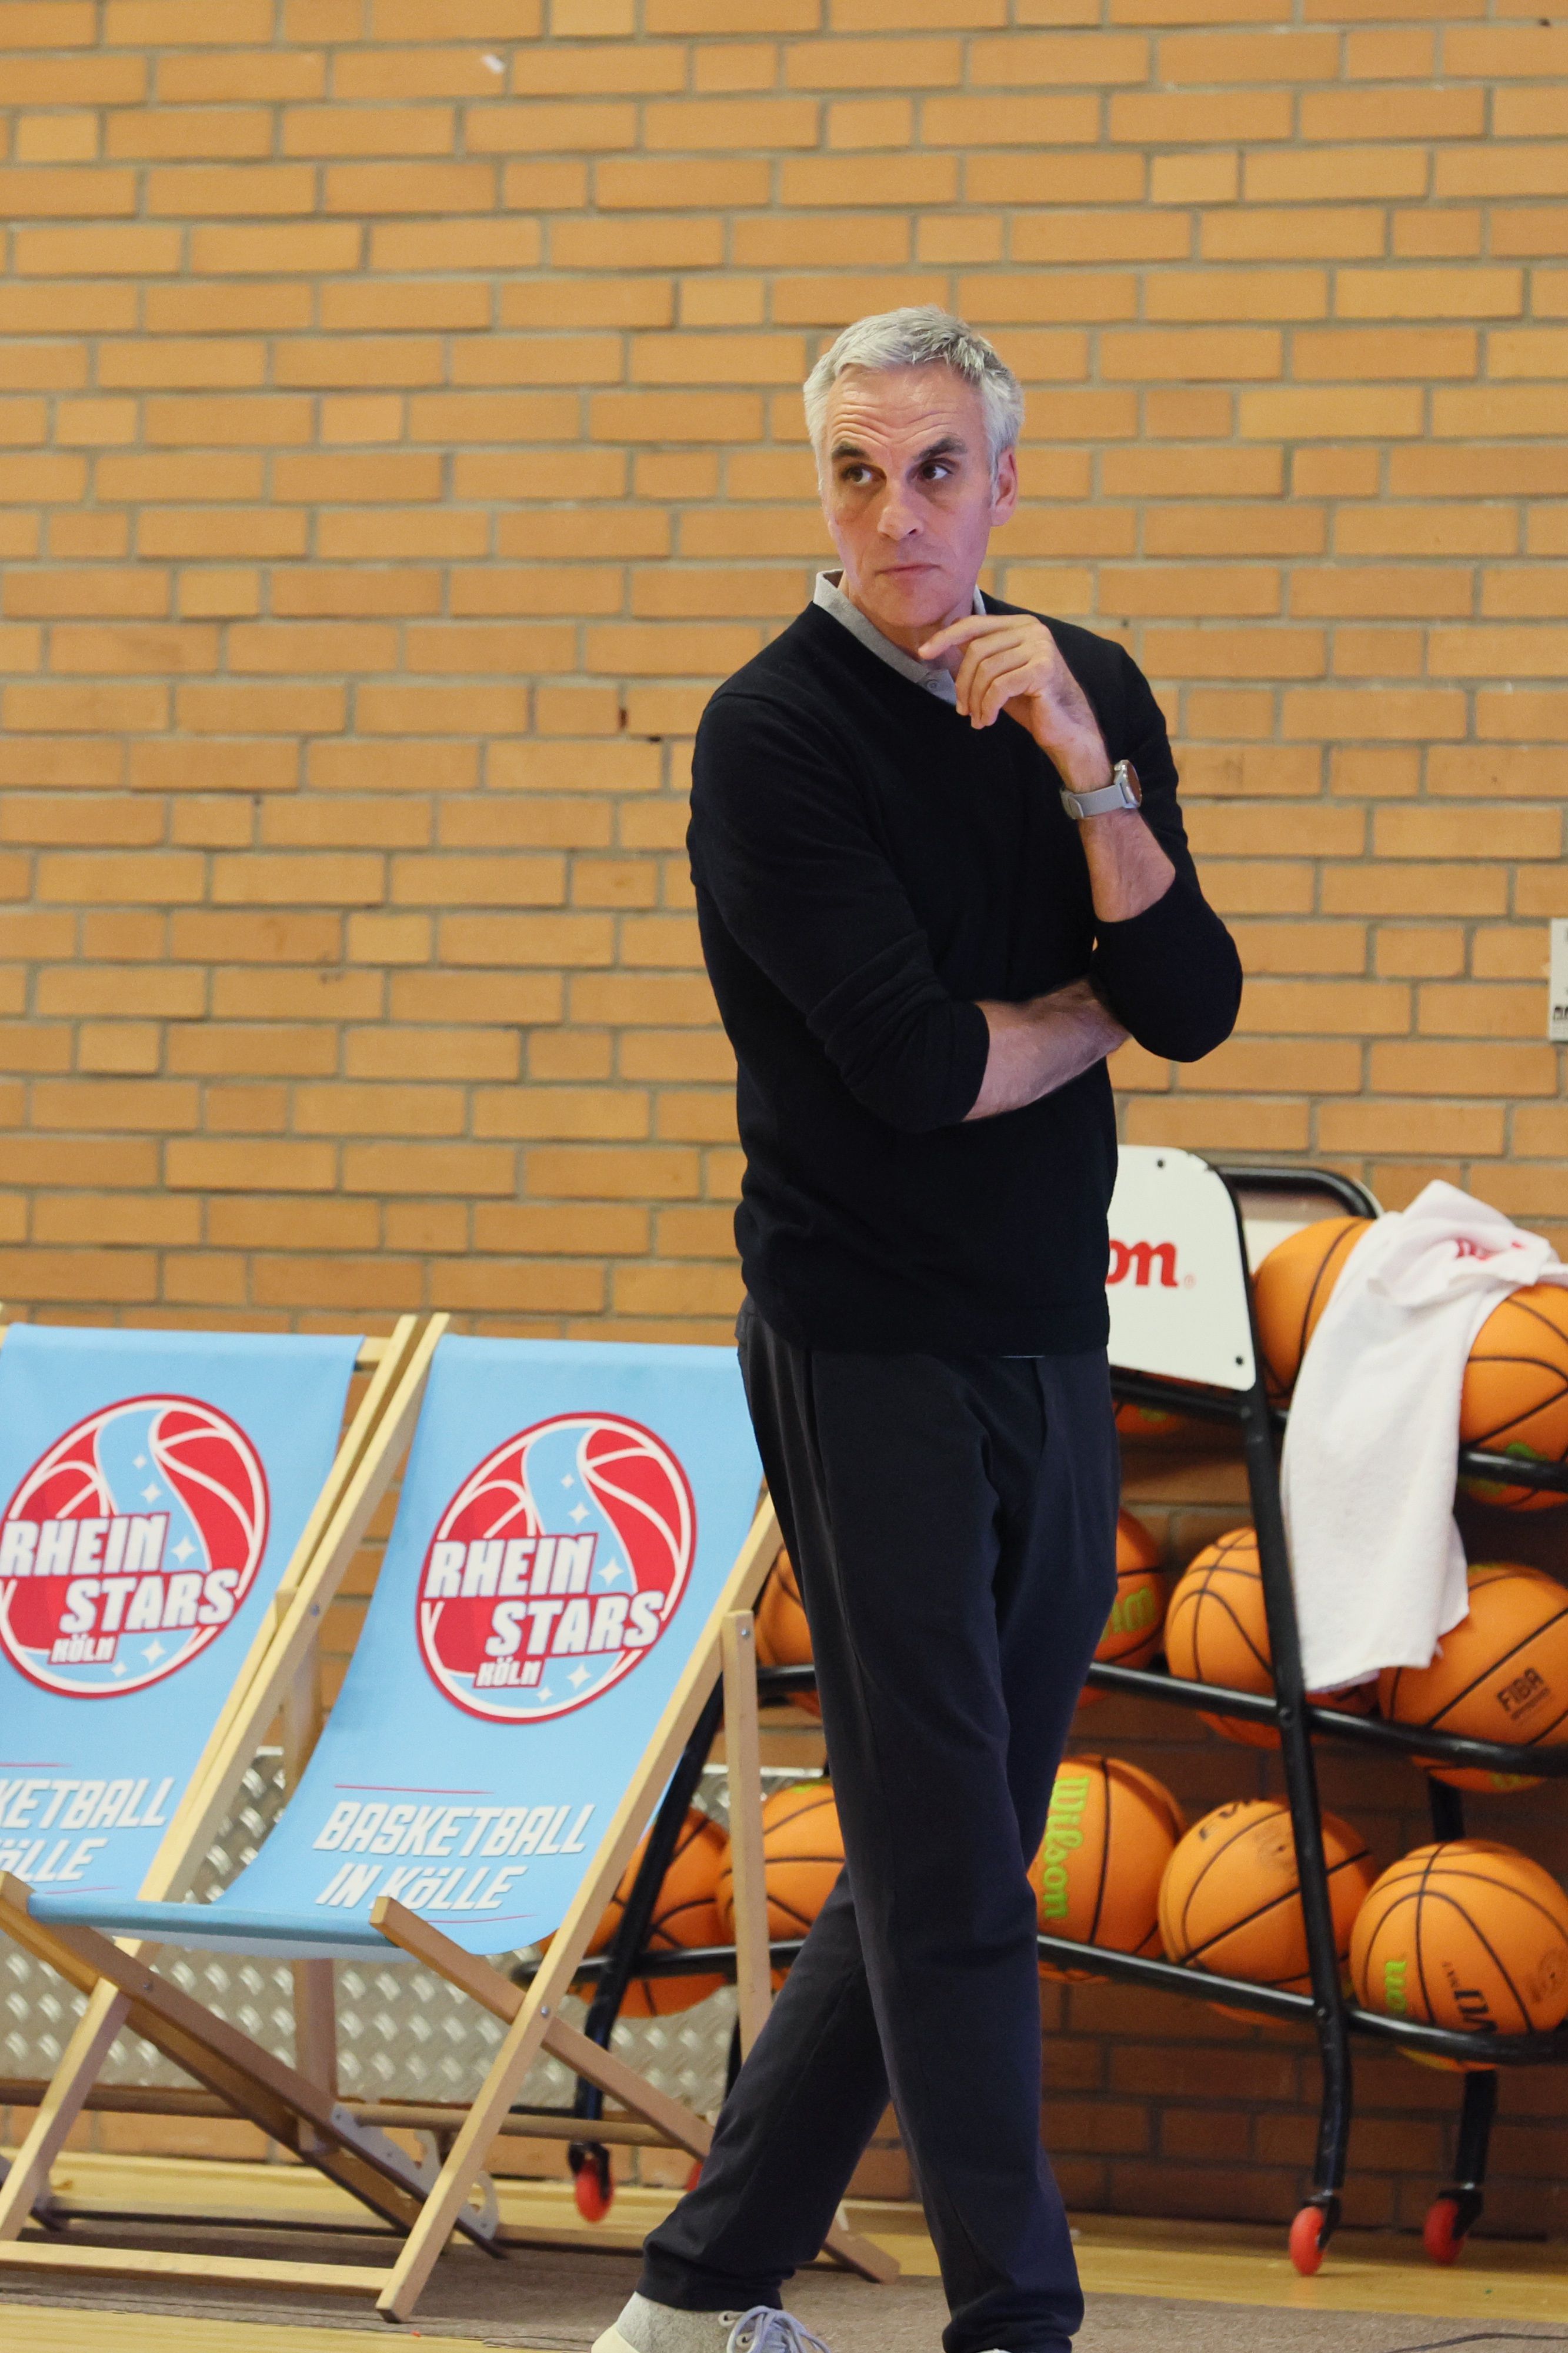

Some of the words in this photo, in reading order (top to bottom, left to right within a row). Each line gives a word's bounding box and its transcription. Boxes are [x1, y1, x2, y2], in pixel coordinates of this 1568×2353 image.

[0, 1512, 166, 1576] RHEIN
[425, 1532, 595, 1598] RHEIN
[60, 1569, 239, 1633] STARS
[485, 1588, 665, 1655] STARS
[50, 1634, 115, 1663] KÖLN
[475, 1657, 542, 1687] KÖLN
[312, 1801, 595, 1857] BASKETBALL
[1043, 1777, 1090, 1918] Wilson
[315, 1862, 383, 1908] IN
[368, 1865, 528, 1910] KÖLLE
